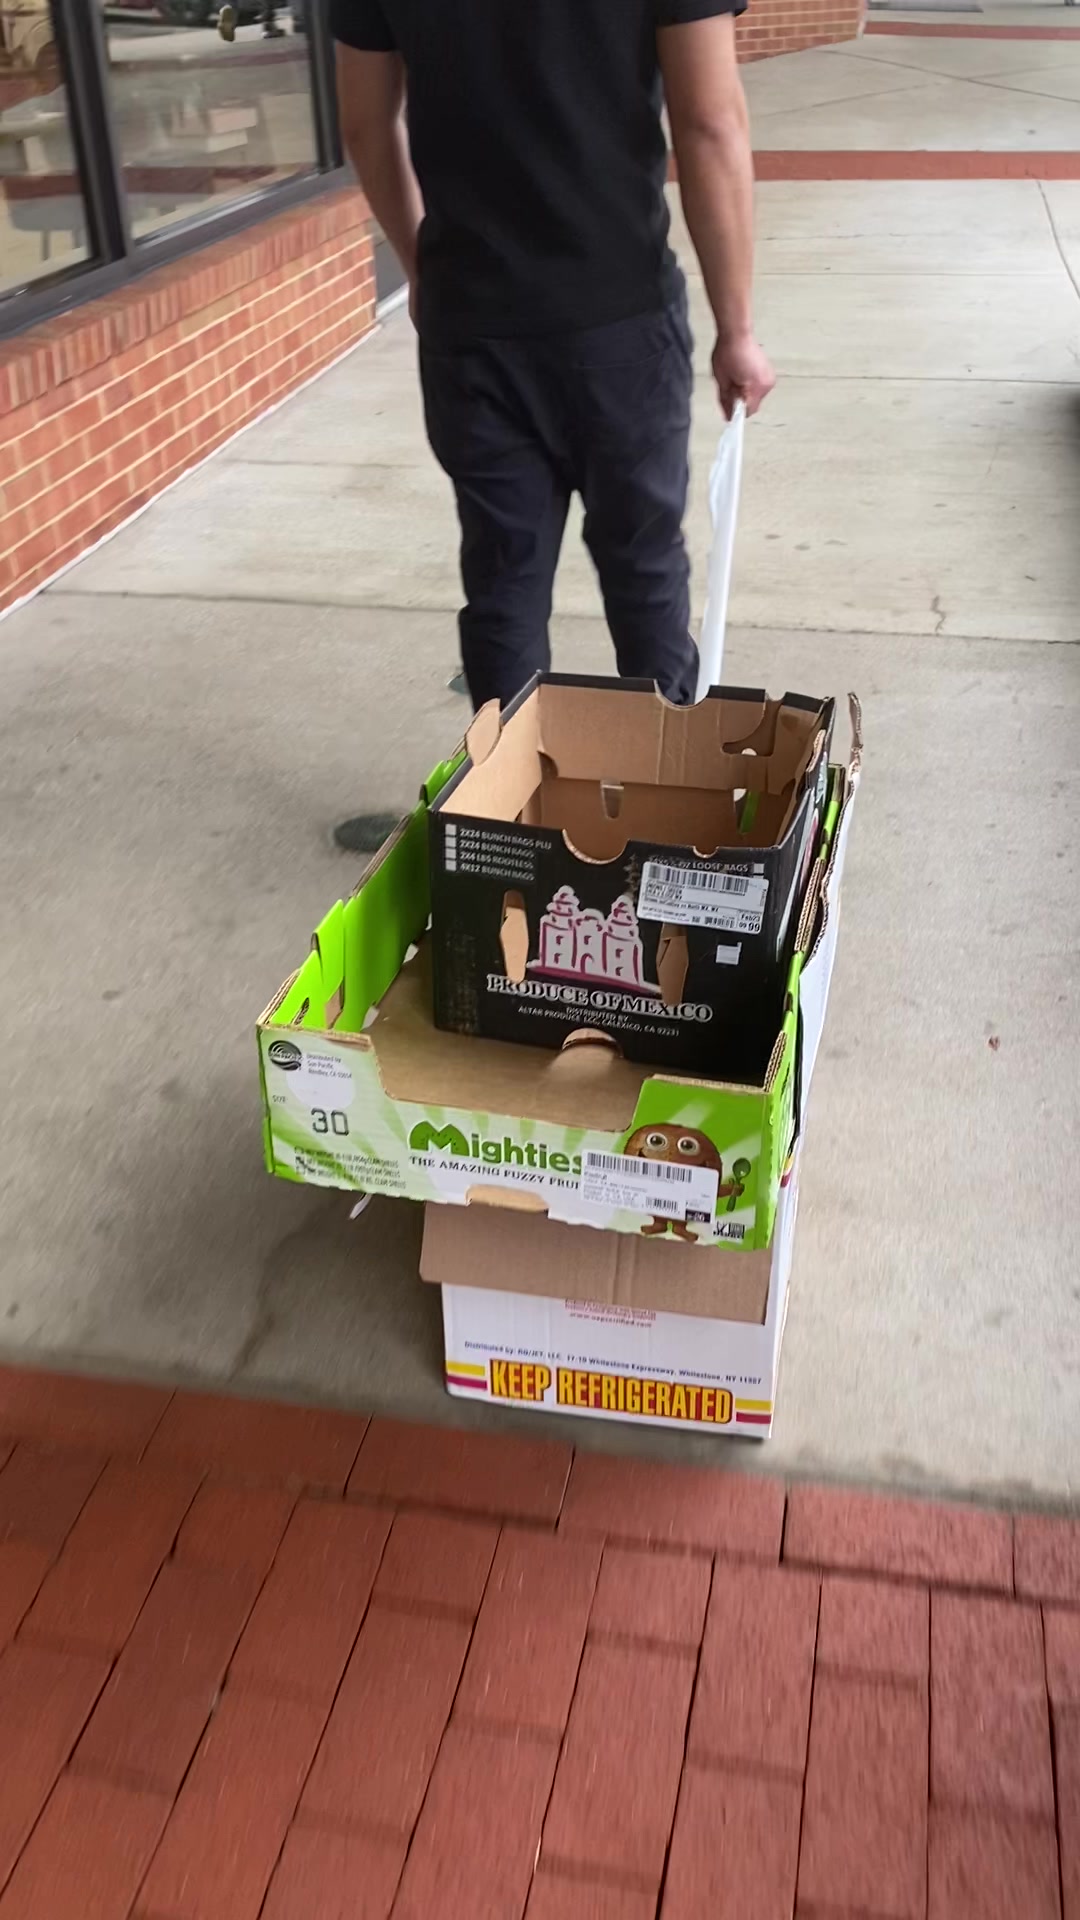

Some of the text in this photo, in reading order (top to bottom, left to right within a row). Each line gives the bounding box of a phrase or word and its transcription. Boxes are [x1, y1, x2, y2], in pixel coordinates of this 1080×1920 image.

[481, 831, 511, 843] BUNCH
[511, 837, 534, 847] BAGS
[481, 842, 511, 854] BUNCH
[511, 847, 535, 858] BAGS
[481, 865, 511, 877] BUNCH
[511, 870, 535, 881] BAGS
[724, 864, 749, 873] BAGS
[487, 973, 714, 1023] PRODUCE OF MEXICO
[518, 1005, 542, 1017] ALTAR
[544, 1009, 582, 1023] PRODUCE
[644, 1025, 656, 1034] CA
[566, 1006, 629, 1022] DISTRIBUTED BY
[311, 1107, 349, 1136] 30
[409, 1120, 582, 1175] Mighties
[409, 1156, 435, 1168] THE
[439, 1160, 500, 1177] AMAZING
[504, 1169, 545, 1184] FUZZY
[550, 1177, 580, 1190] FRUI
[464, 1341, 503, 1353] Distributed
[588, 1356, 630, 1369] Whitestone
[725, 1375, 737, 1383] NY
[490, 1359, 733, 1424] KEEP REFRIGERATED
